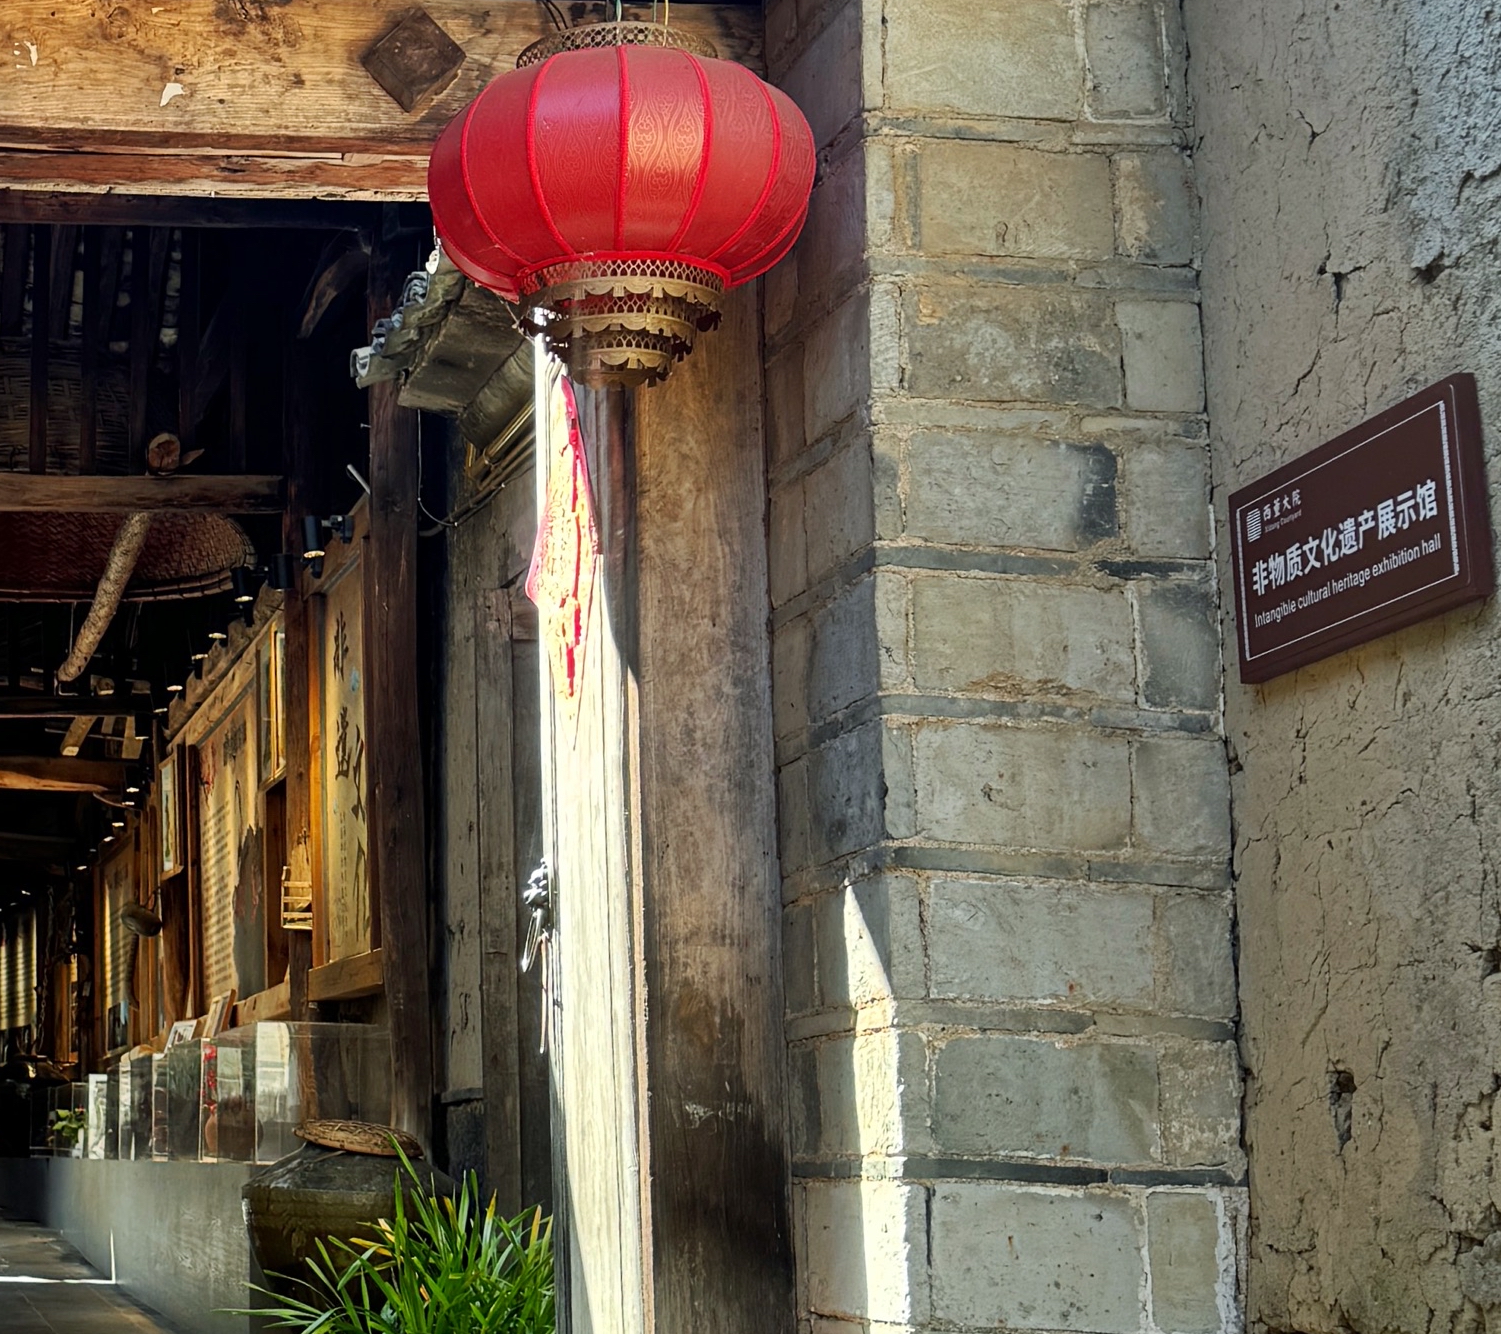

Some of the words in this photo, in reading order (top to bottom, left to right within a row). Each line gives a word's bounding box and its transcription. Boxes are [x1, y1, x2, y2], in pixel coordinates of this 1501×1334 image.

[1252, 479, 1438, 597] 非物质文化遗产展示馆
[1254, 599, 1296, 628] Intangible
[1297, 581, 1331, 610] cultural
[1332, 567, 1371, 595] heritage
[1372, 543, 1420, 577] exhibition
[1421, 532, 1442, 556] hall
